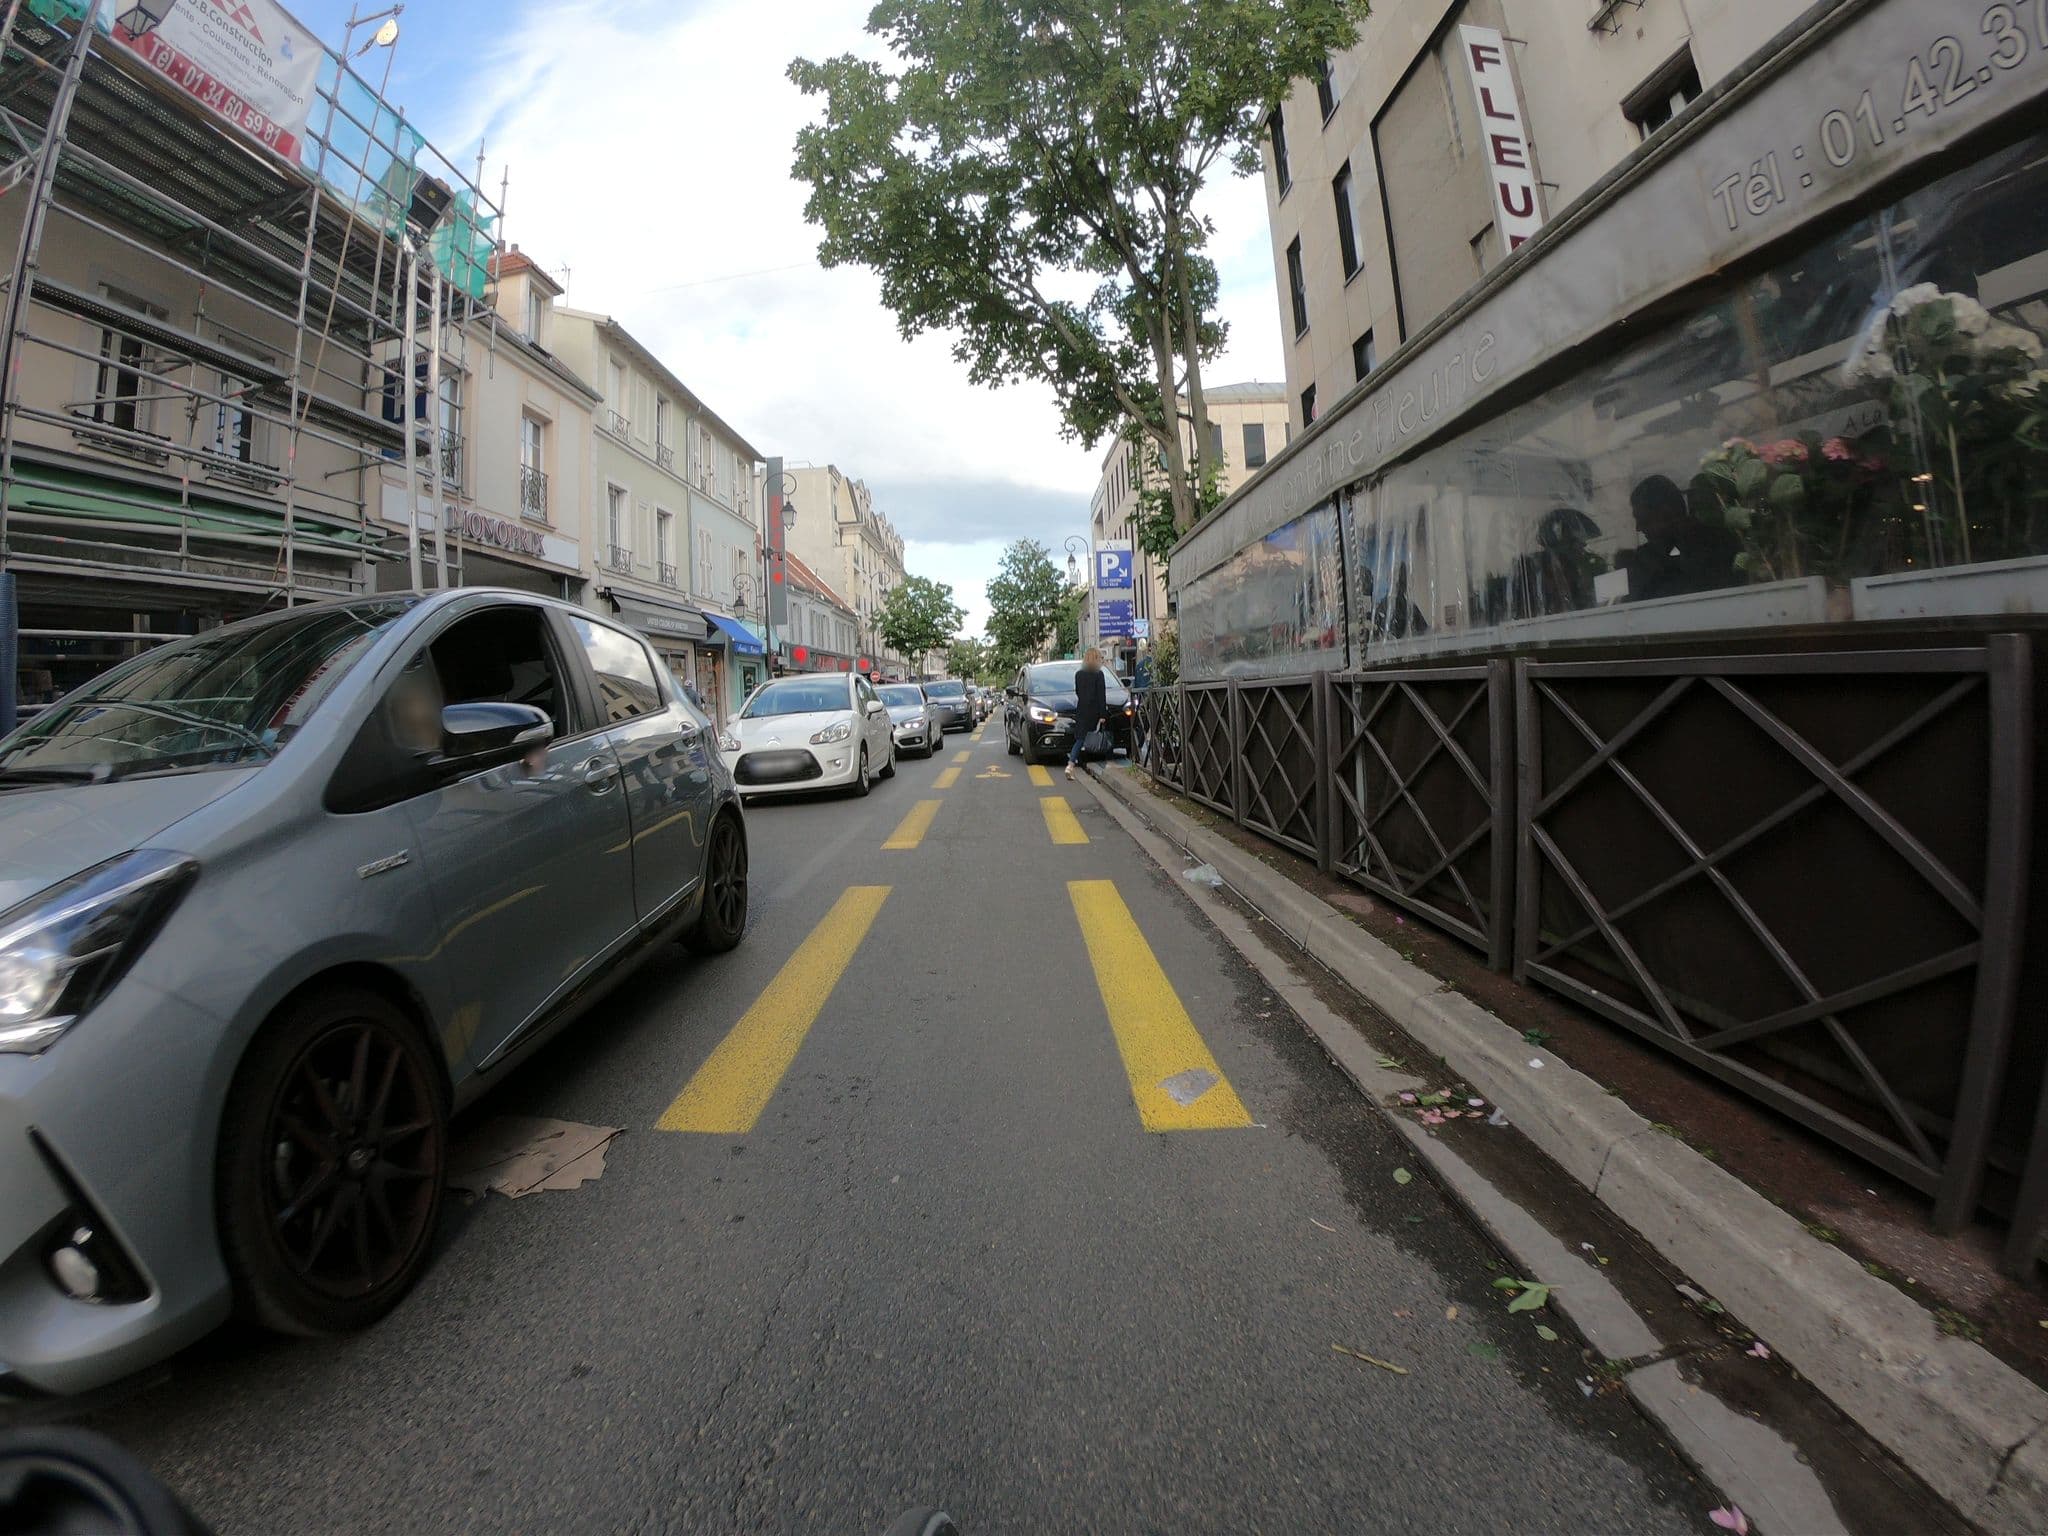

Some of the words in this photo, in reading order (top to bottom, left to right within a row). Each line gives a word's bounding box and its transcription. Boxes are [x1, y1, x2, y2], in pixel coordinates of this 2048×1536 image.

[202, 23, 250, 66] Couverture
[182, 65, 205, 93] 01
[202, 80, 225, 109] 34
[223, 95, 243, 121] 60
[244, 111, 263, 135] 59
[264, 123, 282, 147] 81
[1713, 151, 1785, 231] Tél
[1276, 428, 1365, 514] ontaine
[1371, 331, 1496, 454] Fleurie
[1100, 553, 1120, 578] P
